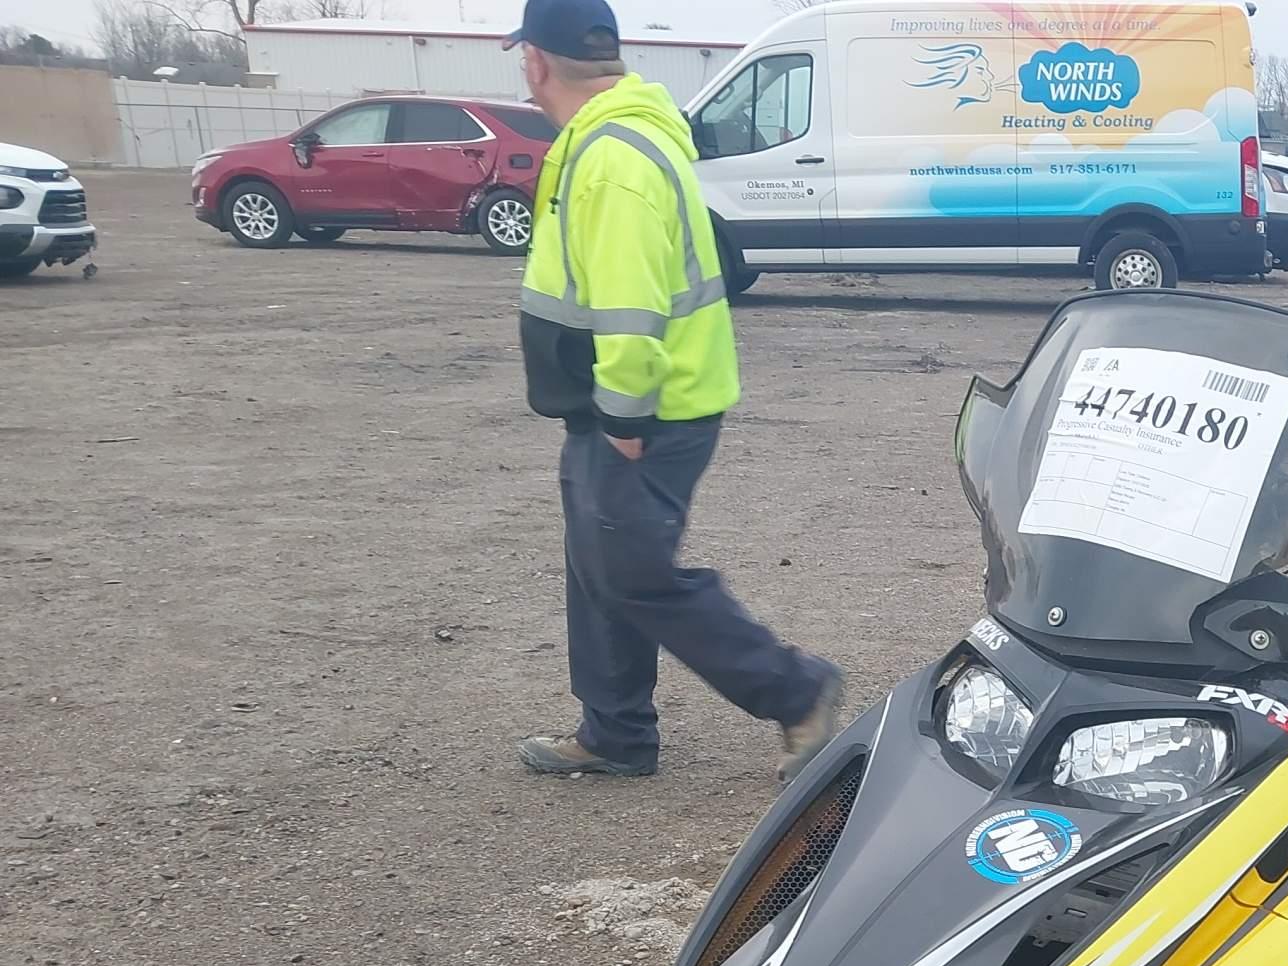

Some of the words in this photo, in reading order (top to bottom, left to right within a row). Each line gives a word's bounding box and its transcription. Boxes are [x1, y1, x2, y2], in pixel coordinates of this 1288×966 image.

[890, 18, 964, 34] Improving
[968, 18, 1001, 31] lives
[1007, 20, 1033, 31] one
[1038, 18, 1088, 34] degree
[1092, 20, 1106, 31] at
[1111, 21, 1122, 31] a
[1126, 19, 1161, 31] time.
[1036, 62, 1115, 81] NORTH
[1049, 82, 1123, 101] WINDS
[1001, 115, 1066, 131] Heating
[1072, 115, 1087, 128] &
[1093, 115, 1154, 131] Cooling
[909, 163, 1033, 177] northwindsusa.com
[1049, 163, 1138, 175] 517-351-6171
[747, 181, 790, 189] Okemos,
[741, 192, 771, 200] USDOT
[1215, 191, 1234, 199] 132
[1074, 385, 1249, 451] 44740180
[1097, 420, 1132, 438] Casualty
[1136, 427, 1183, 448] Insurance
